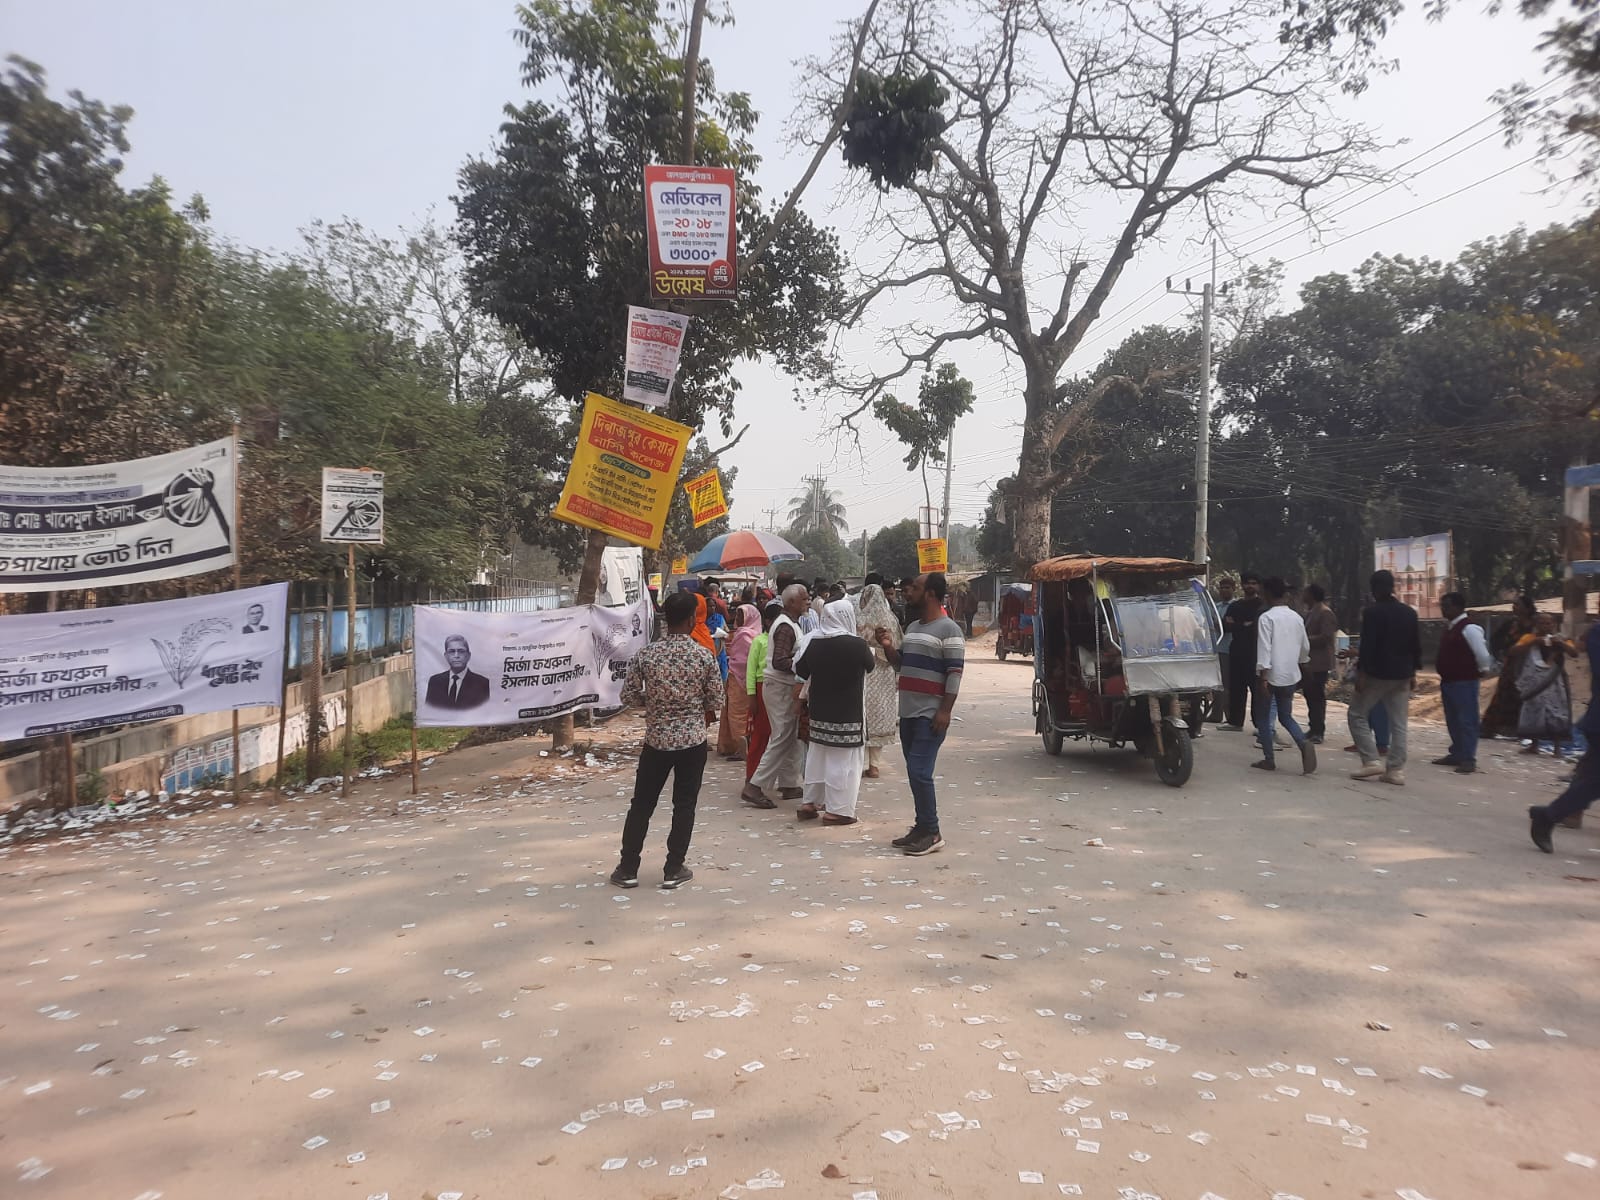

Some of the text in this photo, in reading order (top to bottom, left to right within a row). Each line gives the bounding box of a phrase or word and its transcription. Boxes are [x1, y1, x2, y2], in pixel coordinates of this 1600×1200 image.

[660, 187, 722, 207] মেডিকেল
[675, 217, 690, 229] ২০
[696, 218, 713, 229] ১৮
[670, 249, 717, 260] ৩৩০০+
[655, 270, 706, 295] উন্মেষ
[593, 412, 642, 449] দিনাজপুর
[642, 436, 676, 457] কেয়ার
[594, 435, 625, 455] নার্সিং
[629, 449, 667, 470] কলেজ
[14, 512, 42, 529] মোঃ
[44, 510, 95, 531] খাদেমুল
[95, 504, 137, 526] ইসলাম
[83, 544, 130, 567] ভোট
[136, 537, 173, 560] দিন
[41, 664, 108, 683] ফখরুল
[200, 663, 240, 679] ধানের
[503, 654, 573, 673] মির্জা ফখরুল
[57, 675, 143, 700] আলমগীর
[208, 671, 260, 687] ভোট দিন
[500, 674, 540, 689] ইসলাম
[541, 664, 586, 685] আলমগীর
